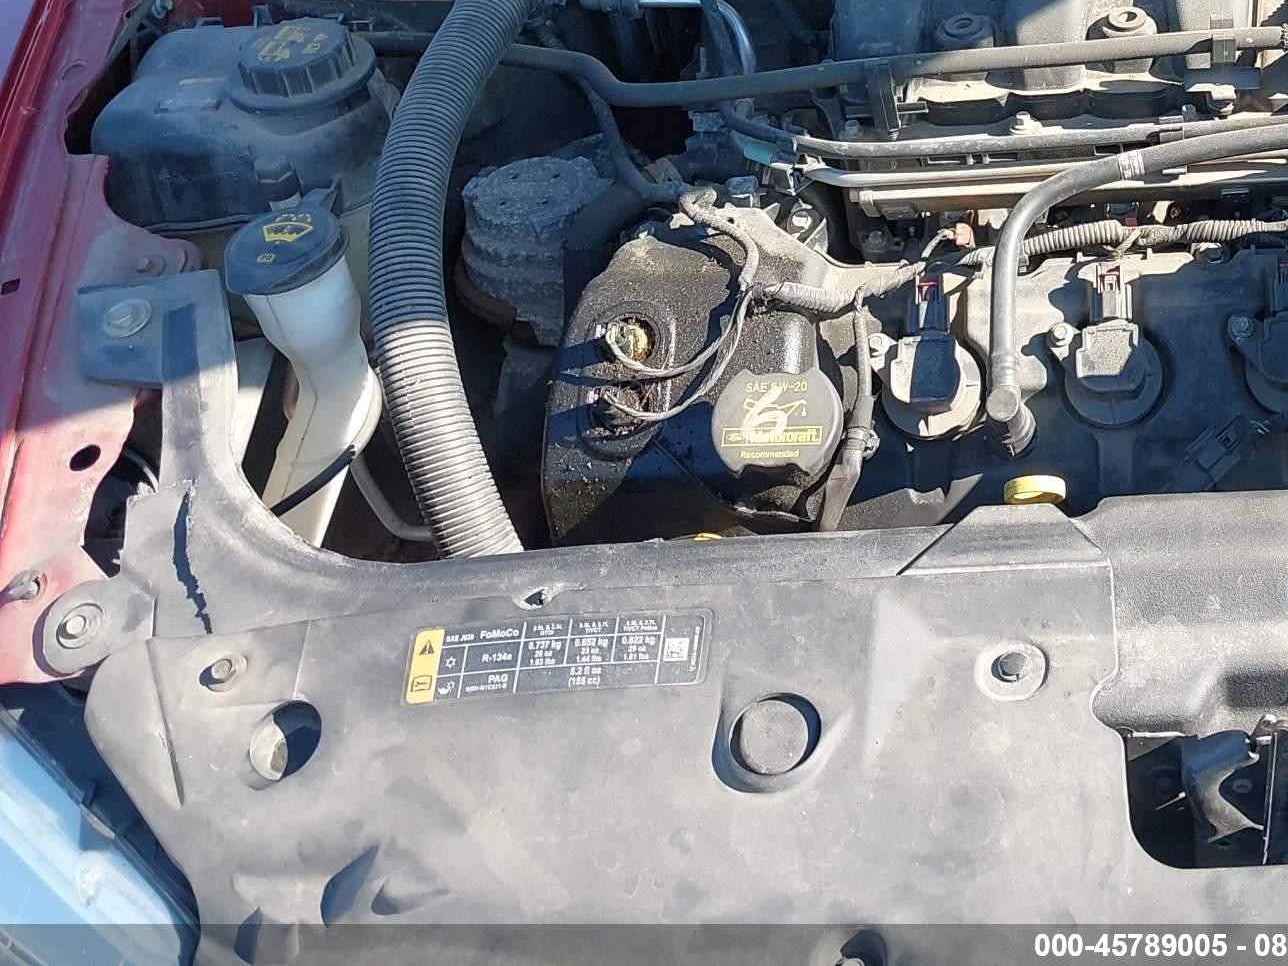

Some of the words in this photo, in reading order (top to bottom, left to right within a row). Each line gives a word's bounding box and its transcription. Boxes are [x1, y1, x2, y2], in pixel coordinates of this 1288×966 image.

[745, 381, 767, 393] SAE
[740, 450, 800, 459] Recommended
[446, 634, 460, 643] SAE
[480, 628, 520, 639] FoMoCo
[528, 640, 550, 650] 0.737
[551, 640, 562, 651] kg
[597, 638, 609, 648] kg
[645, 636, 655, 646] kg
[481, 651, 513, 664] R-134a
[570, 667, 583, 675] 5.2
[591, 666, 602, 674] oz
[488, 673, 509, 684] PAG
[568, 676, 586, 688] (155
[587, 675, 601, 689] cc)
